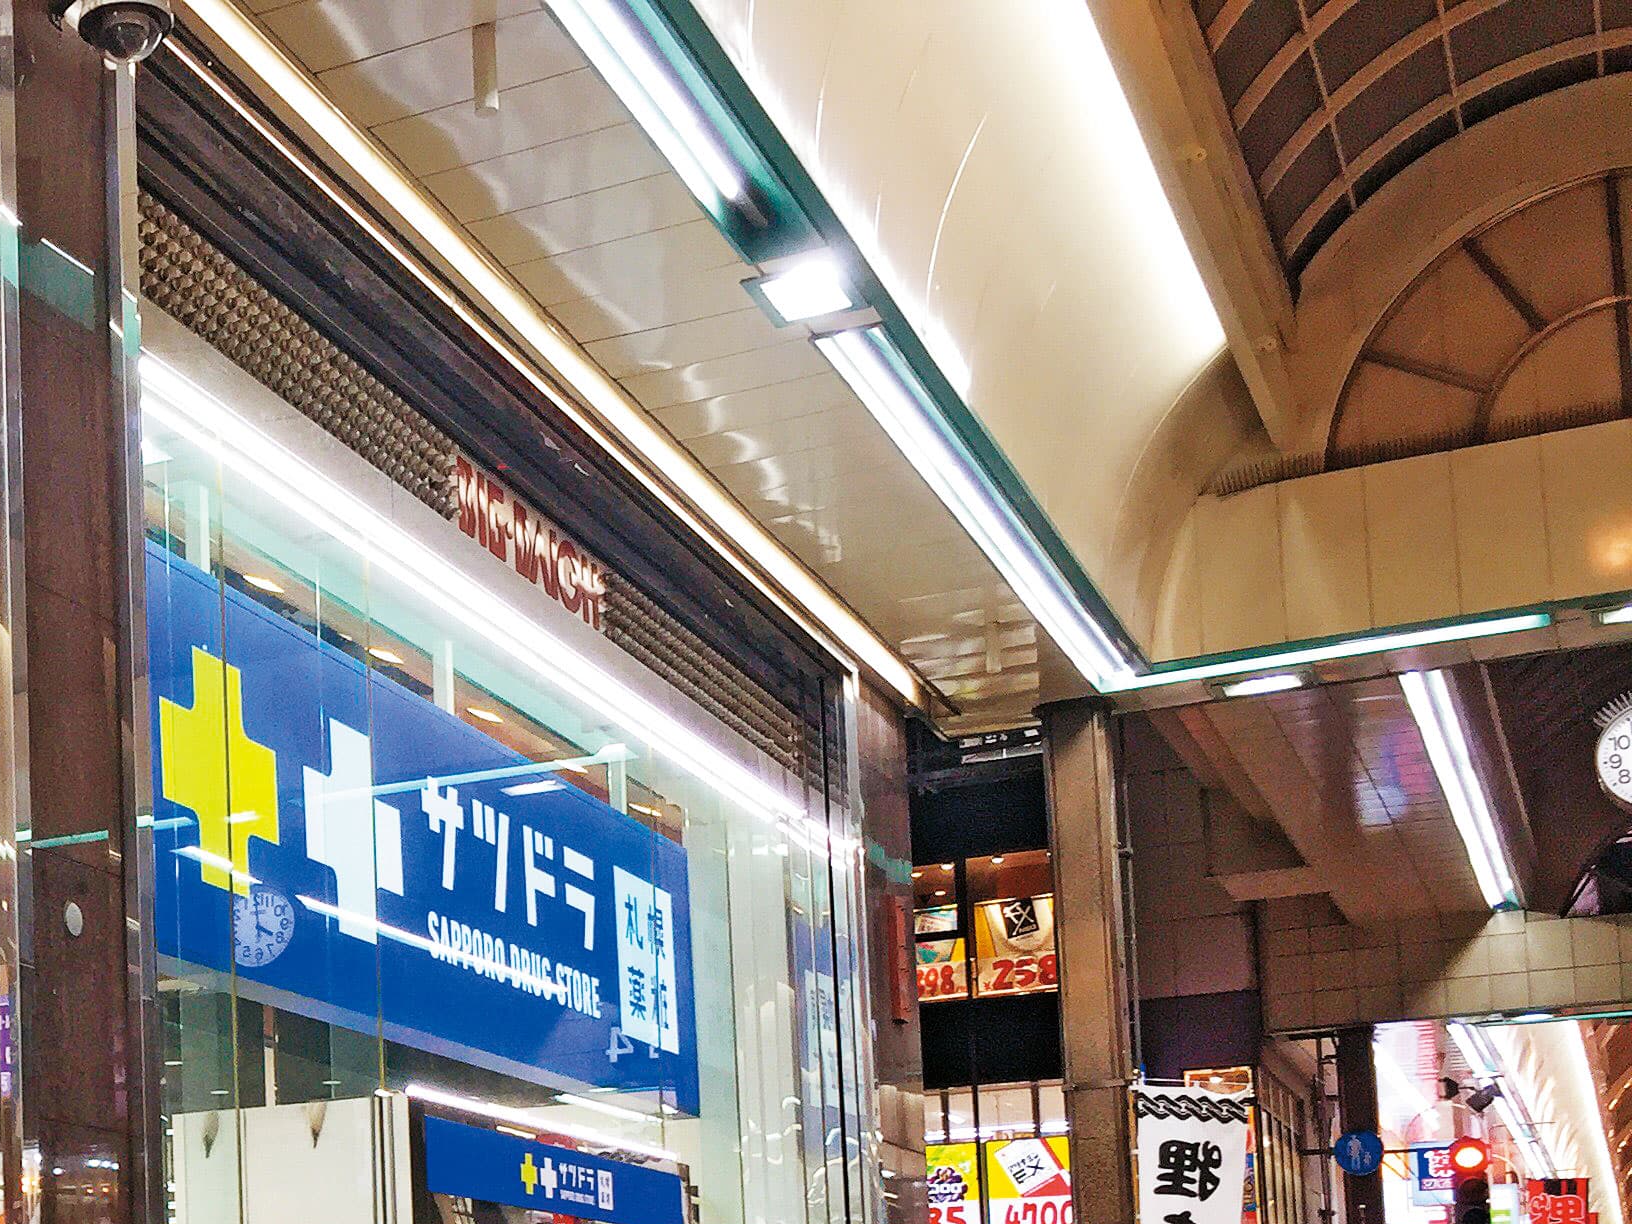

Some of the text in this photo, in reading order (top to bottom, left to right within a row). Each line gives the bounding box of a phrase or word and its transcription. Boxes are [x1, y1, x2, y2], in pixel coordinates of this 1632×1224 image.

[421, 775, 596, 951] サツドラ
[427, 911, 601, 1019] SAPPORO DRUG STORE
